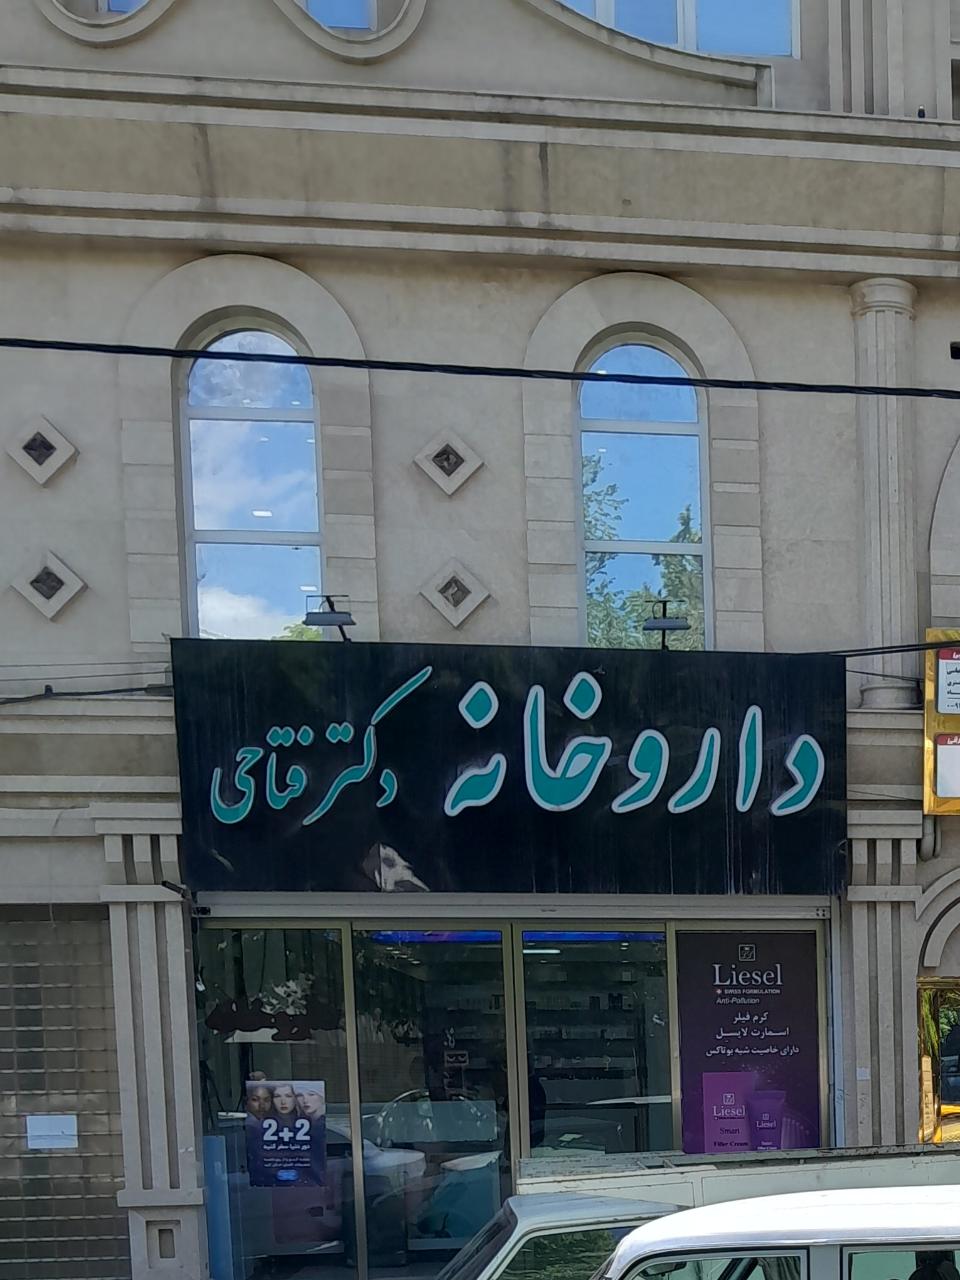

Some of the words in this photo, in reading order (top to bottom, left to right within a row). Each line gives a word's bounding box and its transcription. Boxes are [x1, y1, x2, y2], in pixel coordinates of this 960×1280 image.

[302, 666, 433, 826] دکتر
[444, 671, 825, 817] داروخانه
[210, 724, 314, 826] فتاحی
[712, 963, 784, 986] Liesel
[733, 1012, 751, 1024] فیلر
[752, 1012, 769, 1023] کرم
[750, 1026, 790, 1039] اسمارت
[705, 1045, 734, 1057] بوتاکس
[734, 1045, 751, 1054] شبه
[751, 1045, 779, 1056] خاصیت
[780, 1045, 800, 1056] دارای
[713, 1105, 746, 1117] Liesel
[262, 1118, 311, 1142] 2+2
